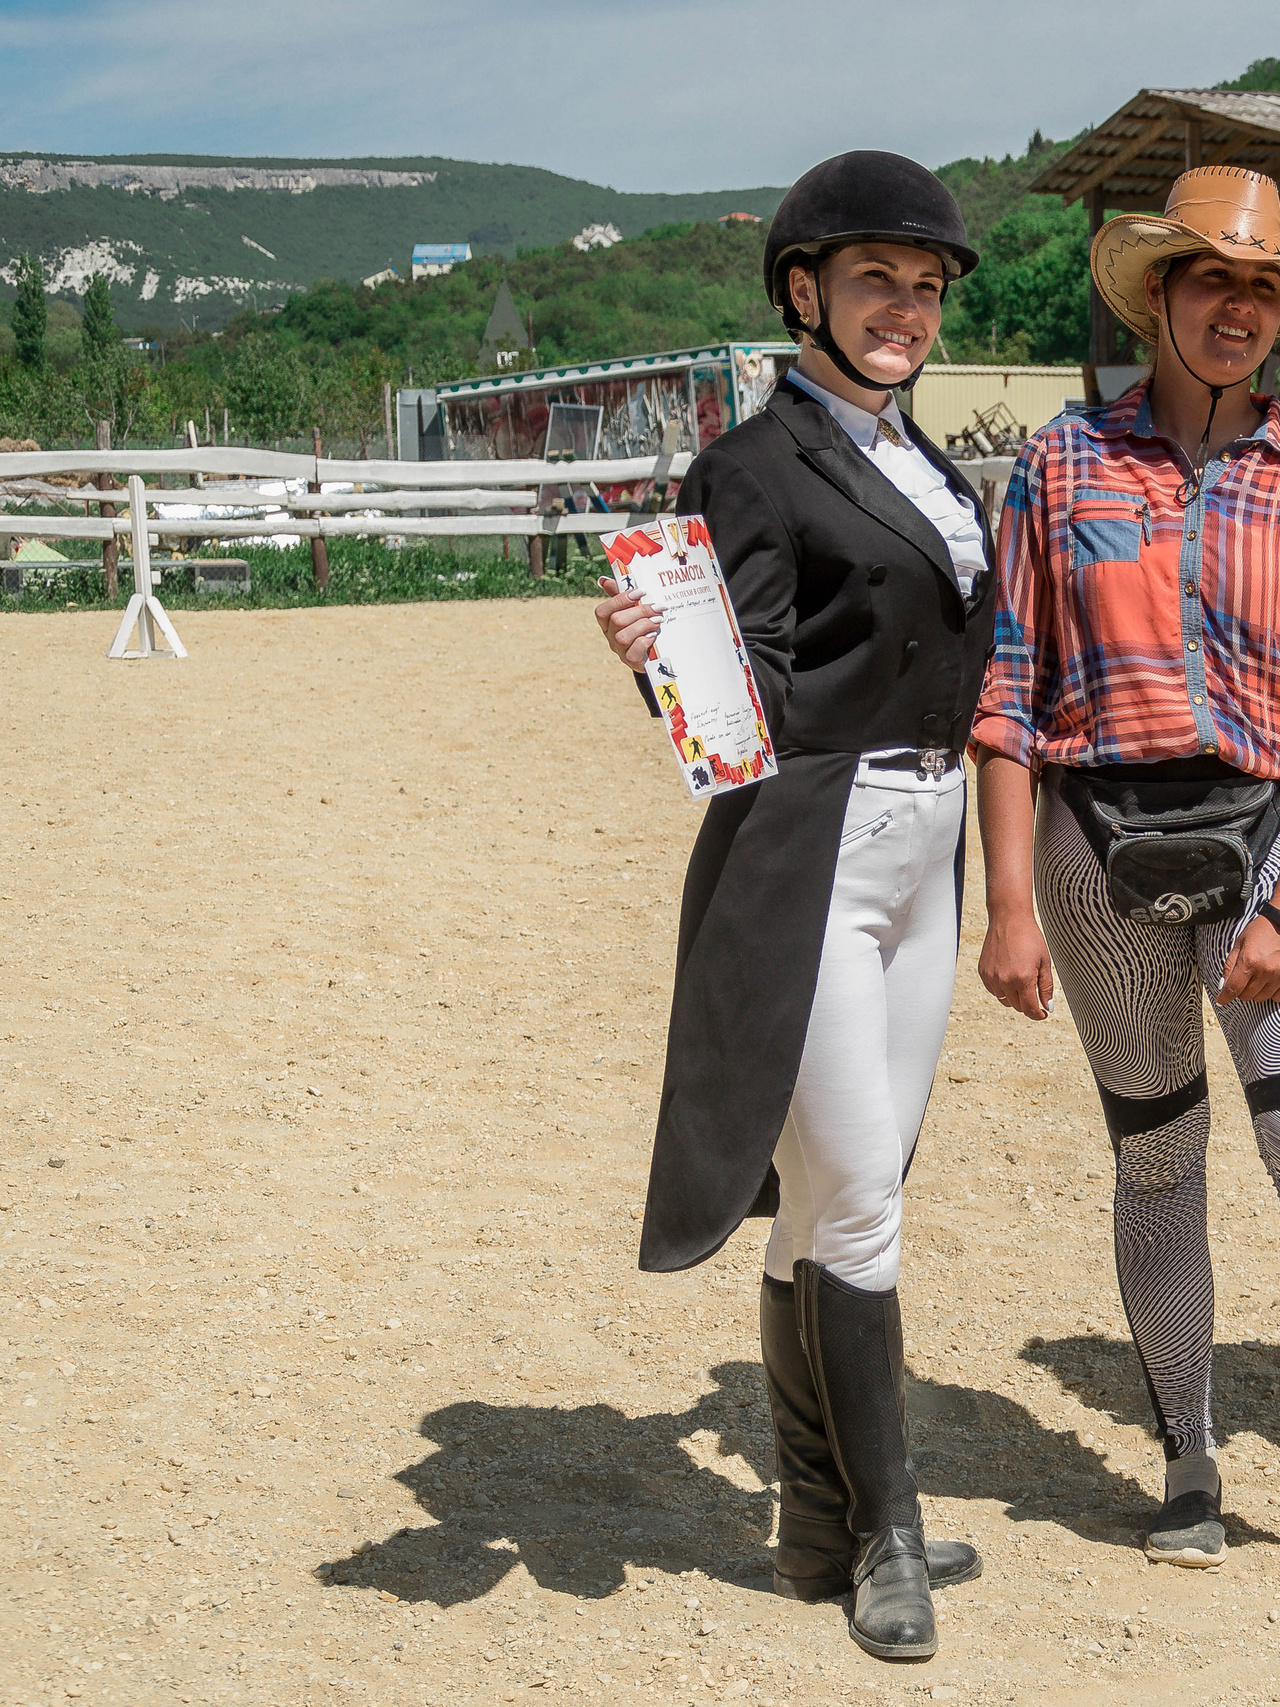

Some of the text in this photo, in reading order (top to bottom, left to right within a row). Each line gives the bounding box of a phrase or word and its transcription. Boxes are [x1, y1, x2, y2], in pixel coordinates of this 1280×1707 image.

[658, 564, 706, 587] ГРАМОТА
[664, 594, 672, 602] ЗА
[672, 588, 694, 599] УСПЕХИ
[697, 585, 712, 595] СПОРТЕ
